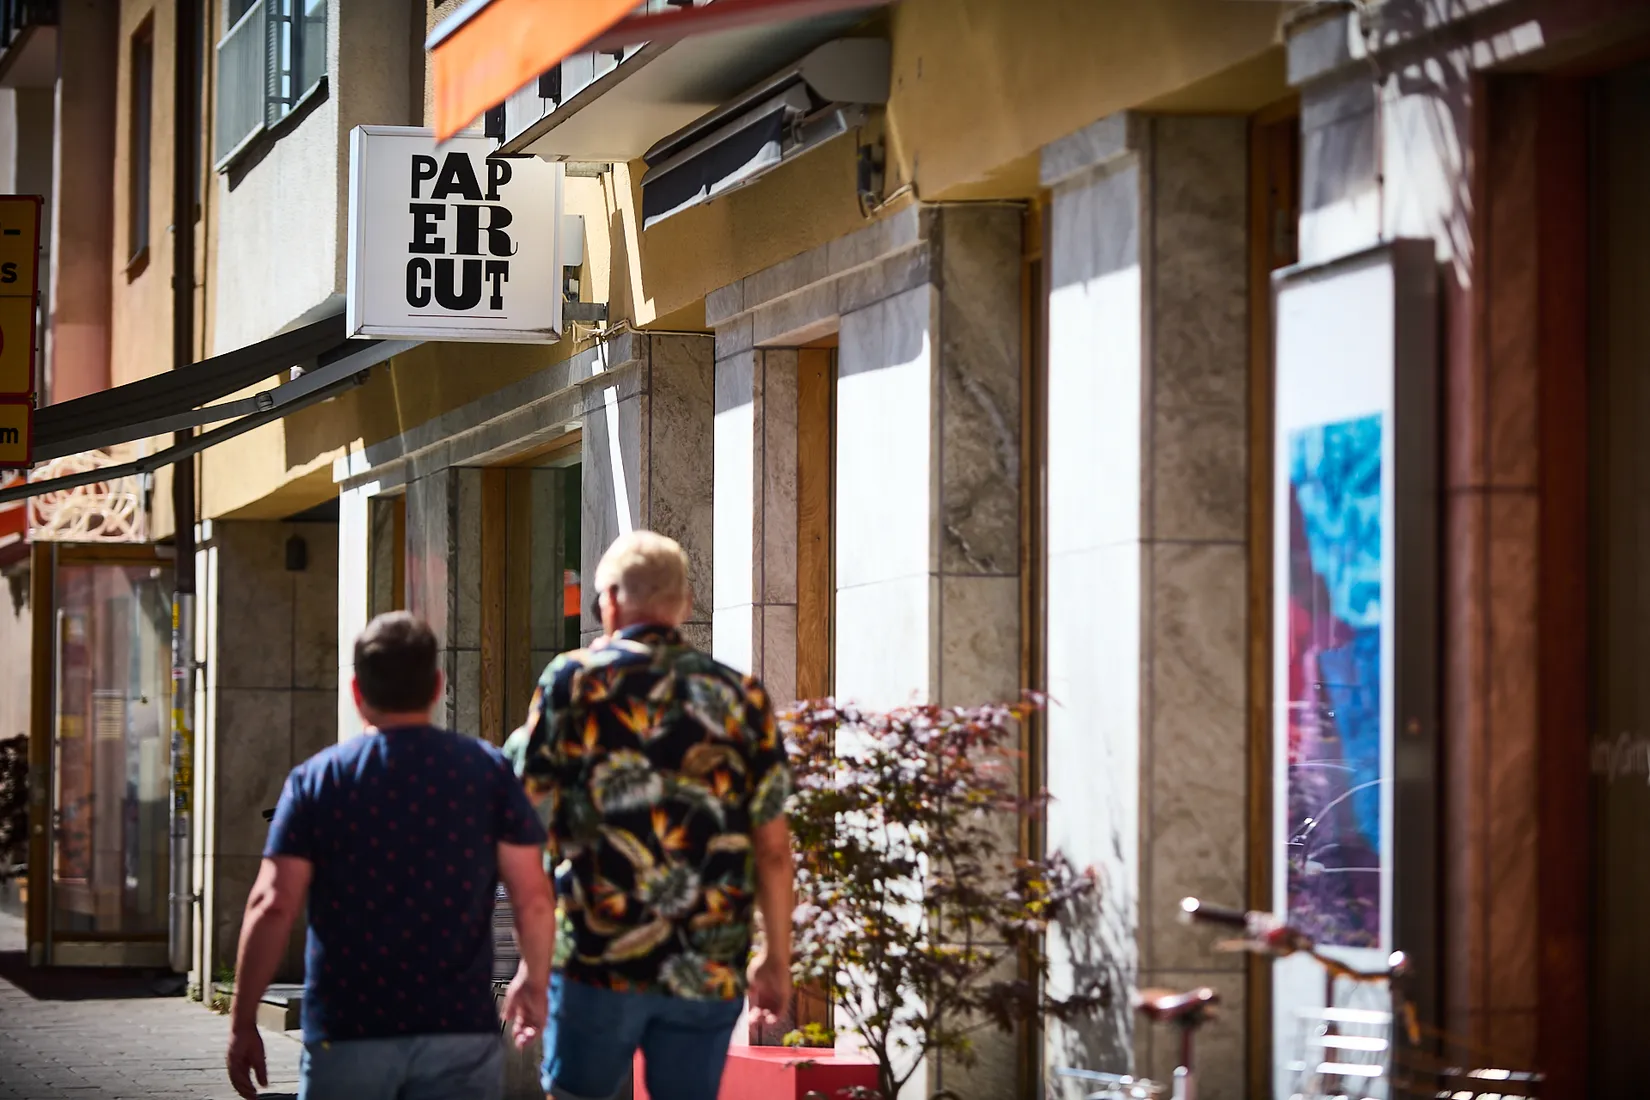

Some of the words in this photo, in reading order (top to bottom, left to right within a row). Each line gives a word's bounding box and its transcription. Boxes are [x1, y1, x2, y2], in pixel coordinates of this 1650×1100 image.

[410, 152, 513, 202] PAP
[408, 203, 519, 257] ER
[405, 257, 510, 311] CUT
